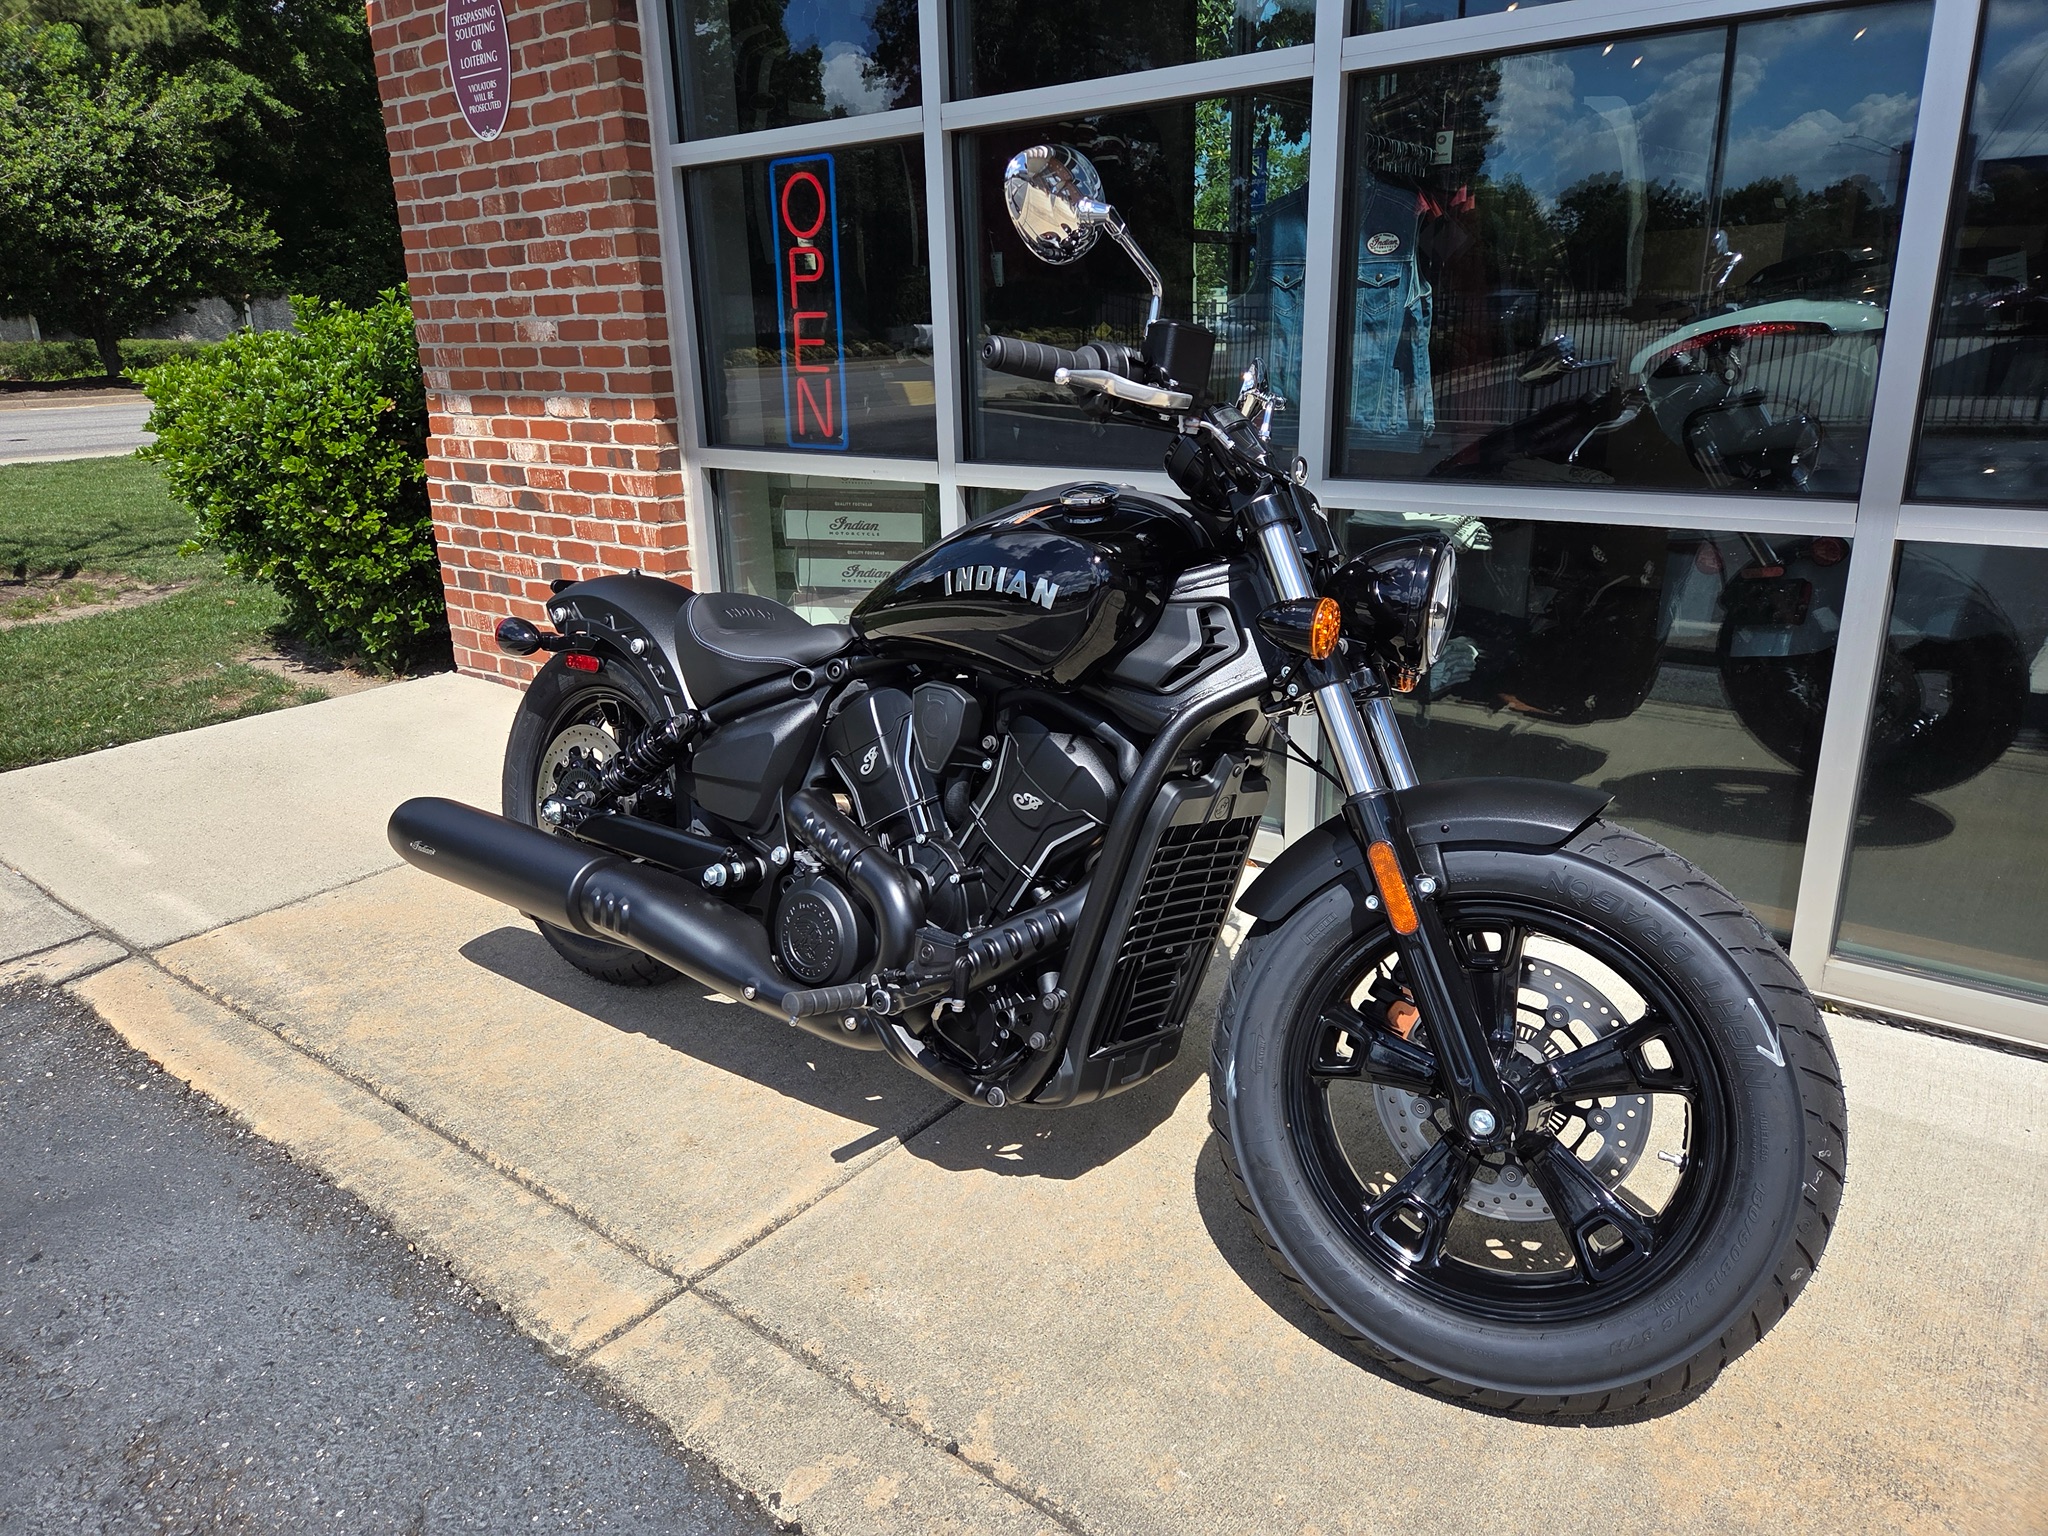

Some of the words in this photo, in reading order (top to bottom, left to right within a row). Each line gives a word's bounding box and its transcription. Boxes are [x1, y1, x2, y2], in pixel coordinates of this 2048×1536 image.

[451, 4, 496, 27] TRESPASSING
[455, 20, 496, 41] SOLICITING
[471, 39, 483, 52] OR
[460, 50, 498, 70] LOITERING
[468, 80, 497, 93] VIOLATORS
[474, 92, 487, 103] WILL
[487, 90, 495, 100] BE
[469, 100, 502, 115] PROSECUTED
[781, 171, 834, 437] OPEN
[829, 516, 879, 531] Indian
[841, 564, 891, 578] Indian
[944, 565, 1060, 610] INDIAN
[410, 840, 436, 856] Indian
[1541, 869, 1697, 965] DRAGON
[1691, 976, 1771, 1090] NIGHT
[1655, 1288, 1687, 1318] FRONT
